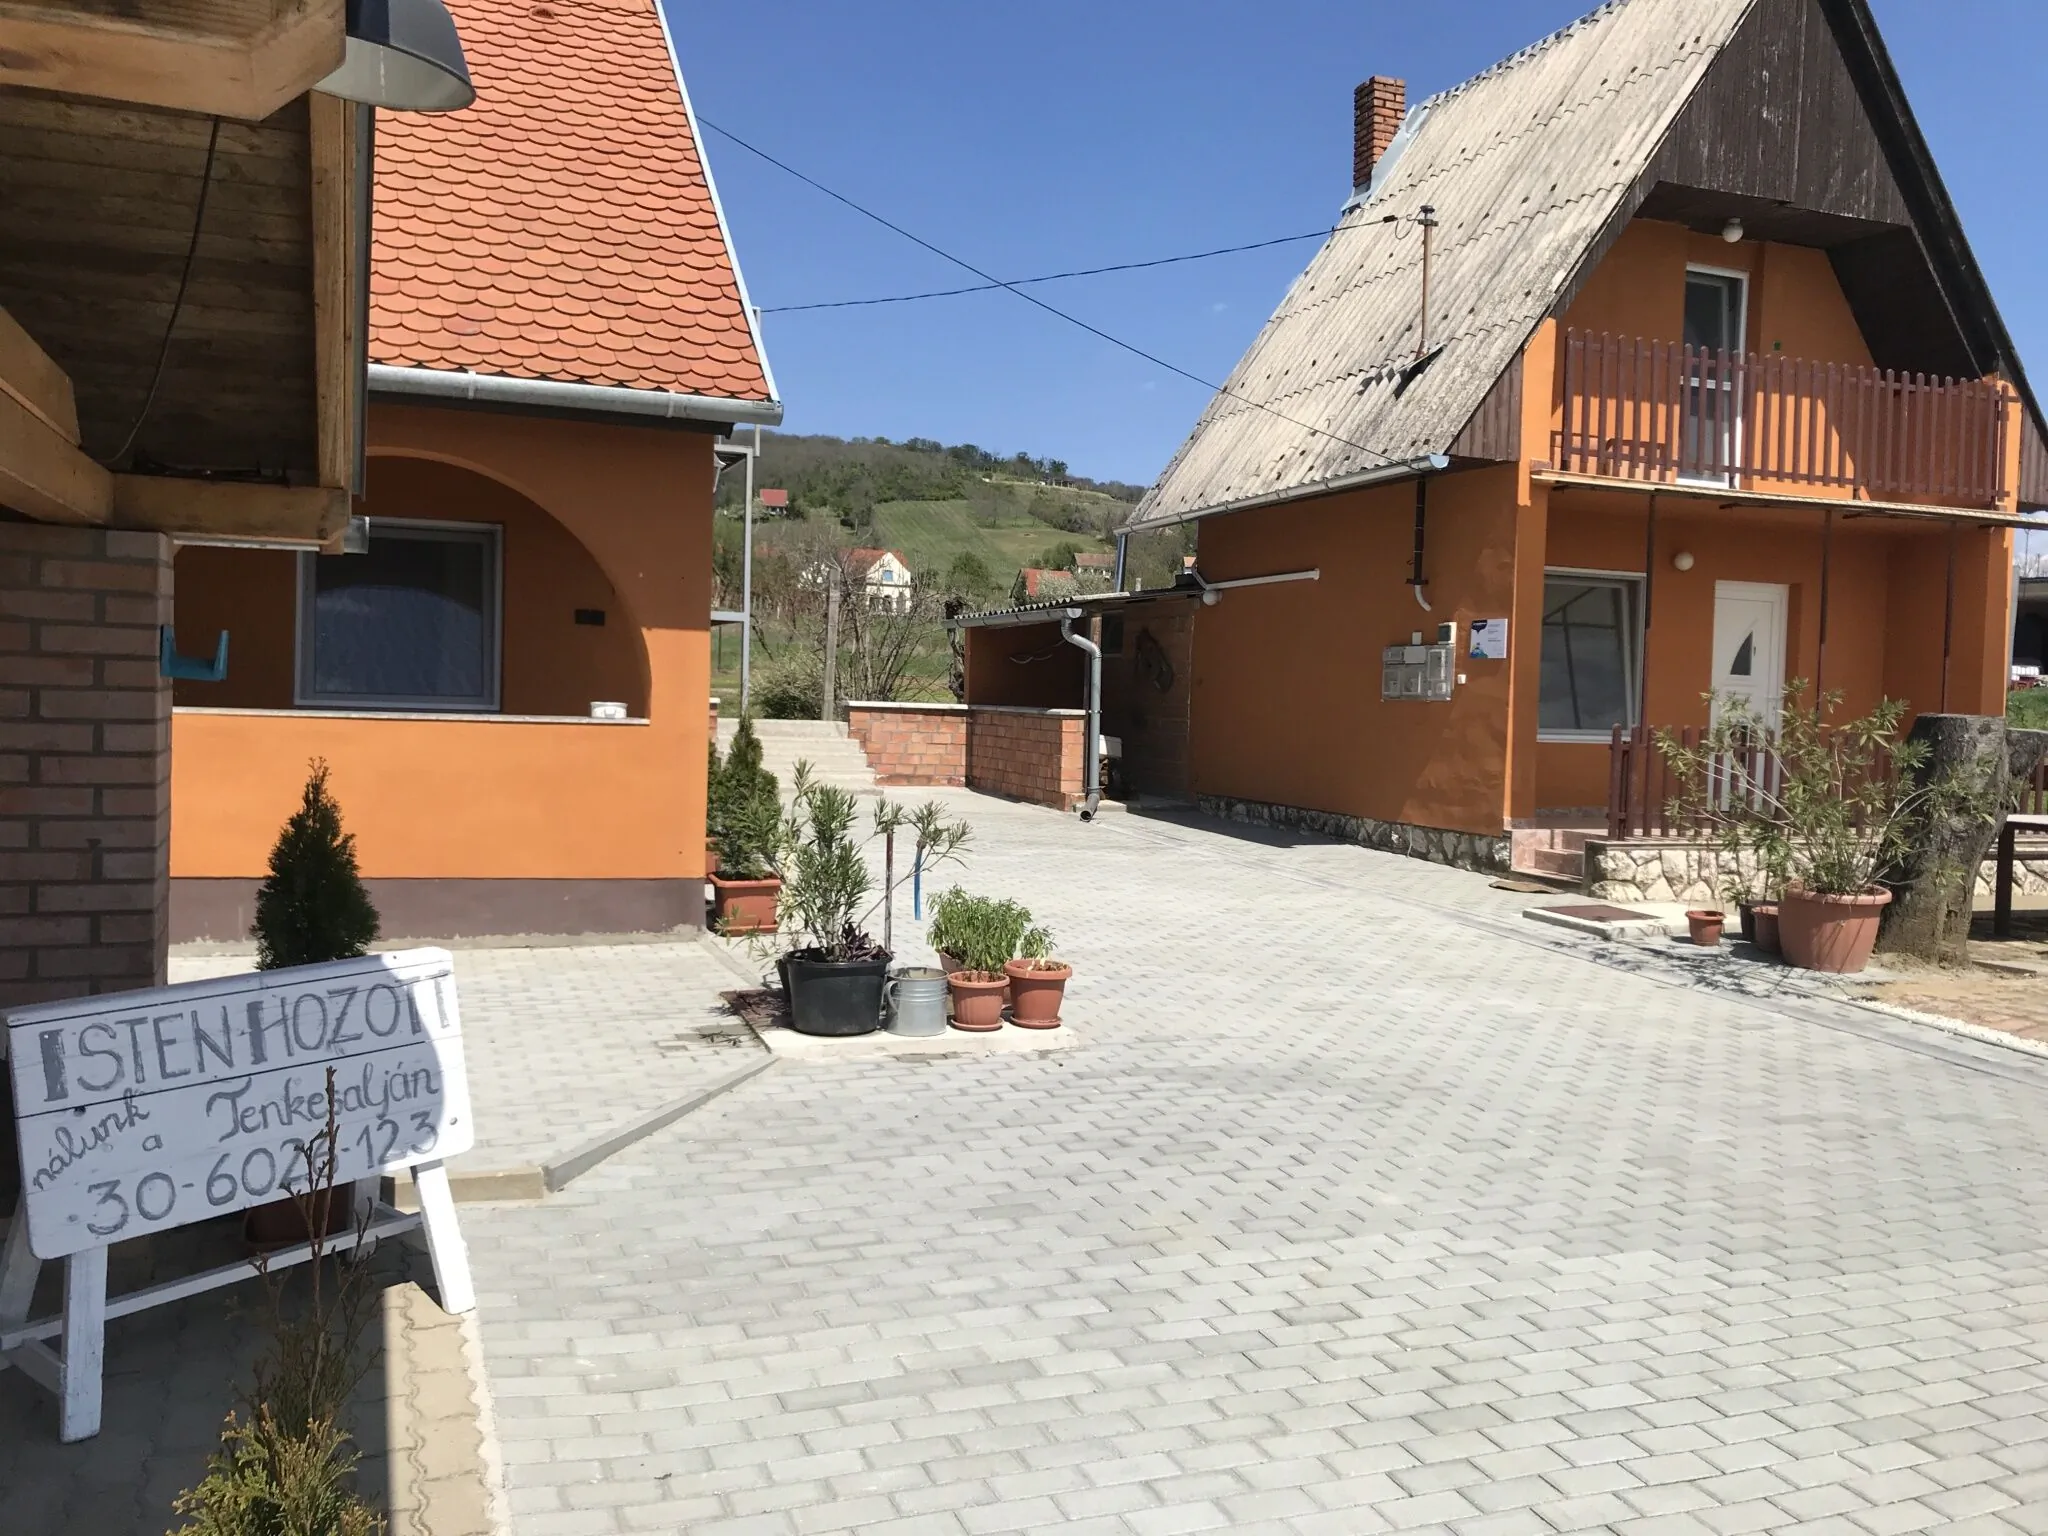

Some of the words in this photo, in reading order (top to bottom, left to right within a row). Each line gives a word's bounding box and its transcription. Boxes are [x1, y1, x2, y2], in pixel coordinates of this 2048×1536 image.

[39, 1005, 235, 1102] ISTEN
[244, 969, 451, 1065] HOZOTT
[32, 1087, 150, 1191] nálunk
[142, 1134, 164, 1152] a
